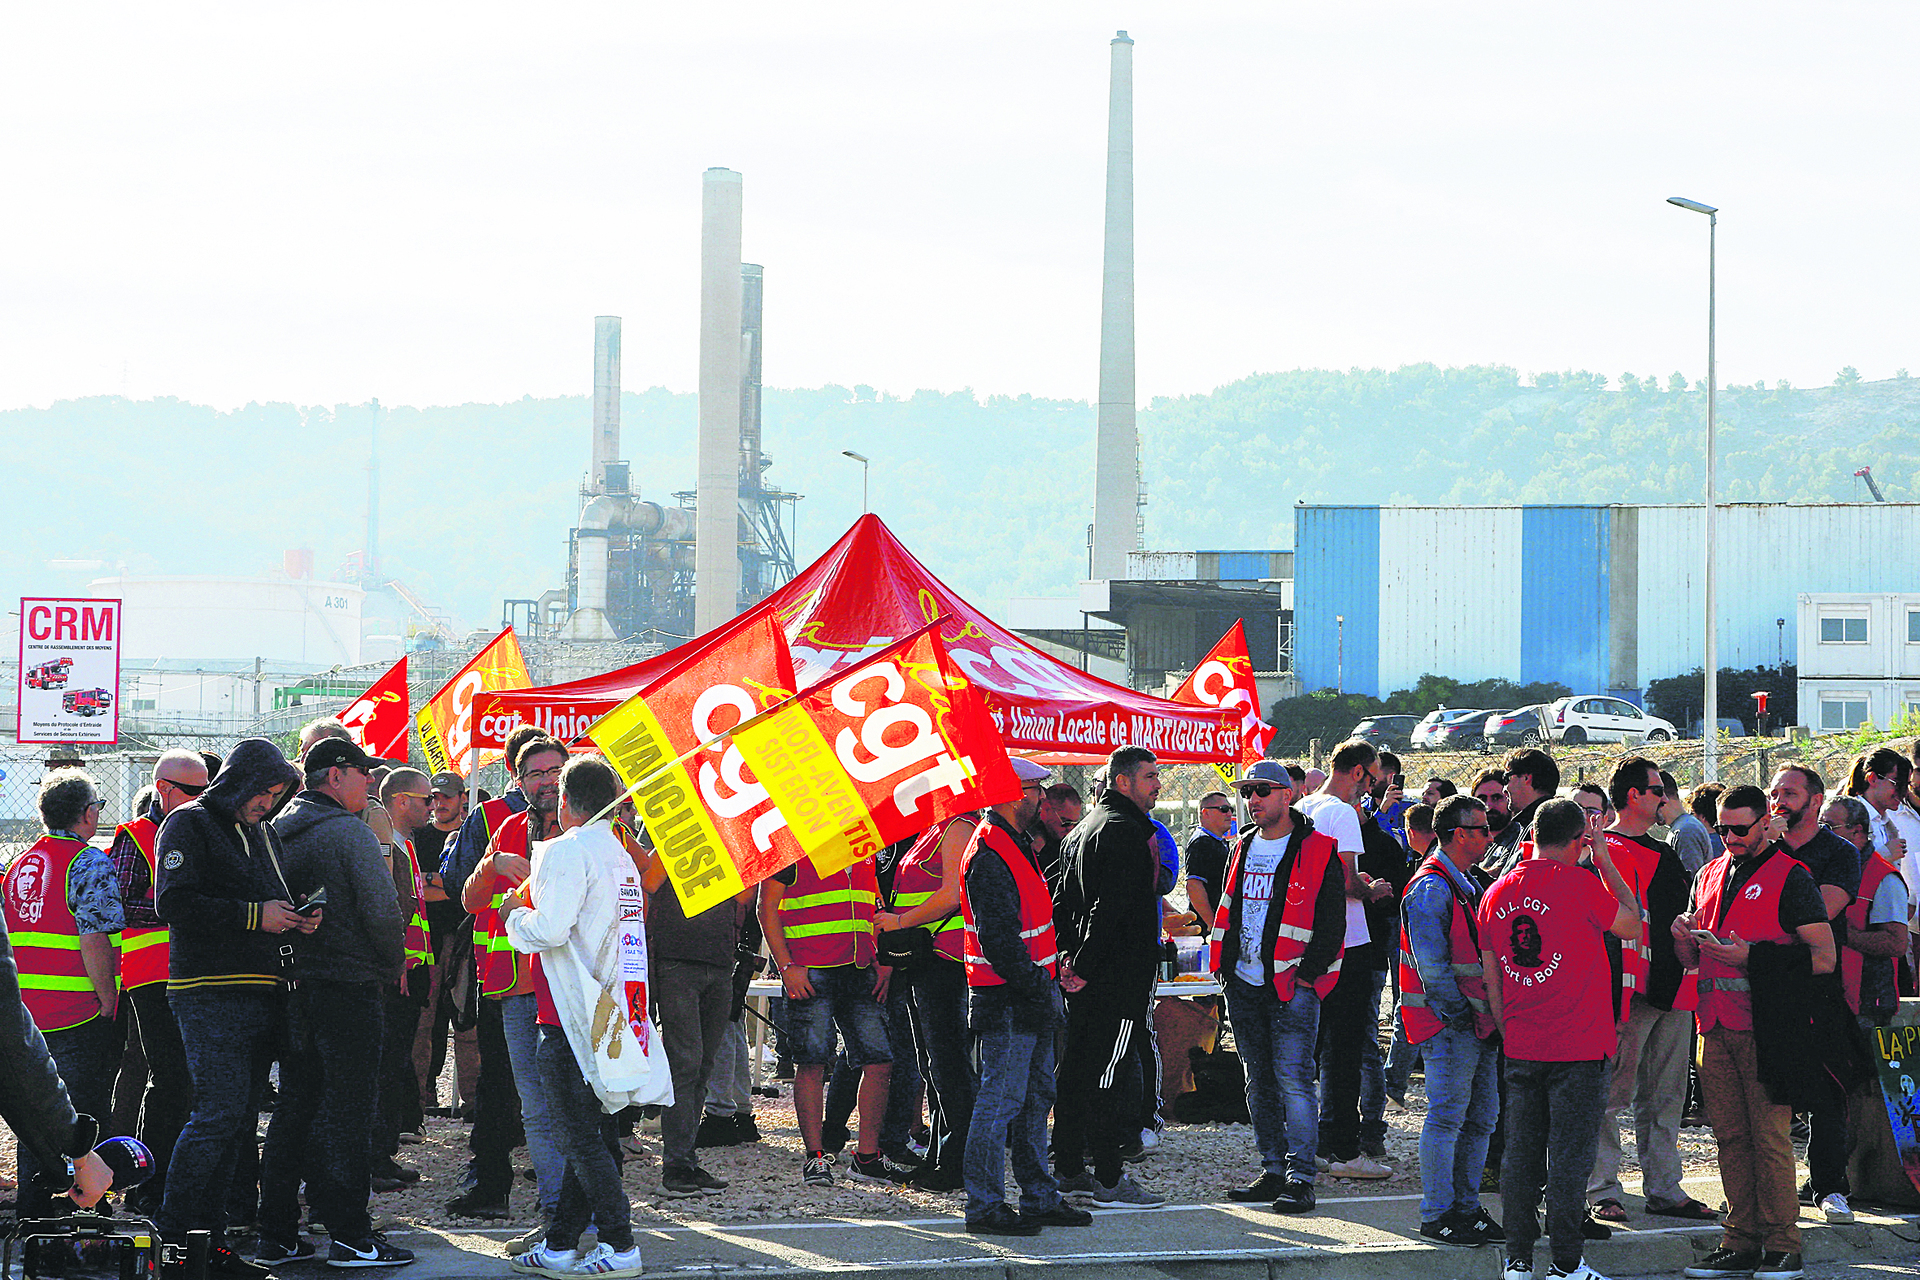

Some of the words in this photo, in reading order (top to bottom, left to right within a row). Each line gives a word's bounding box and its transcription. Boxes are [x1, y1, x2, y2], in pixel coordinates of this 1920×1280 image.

[325, 596, 332, 608] A
[334, 597, 348, 609] 301
[28, 606, 113, 641] CRM
[482, 697, 522, 715] la
[421, 720, 432, 738] UL
[480, 710, 522, 742] cgt
[831, 661, 977, 817] cgt
[1010, 706, 1055, 741] Union
[1057, 710, 1106, 744] Locale
[1110, 713, 1127, 745] de
[1131, 715, 1215, 752] MARTIGUES
[1216, 727, 1240, 756] cgt
[756, 738, 831, 834] SISTERON
[608, 721, 726, 898] VAUCLUSE
[19, 898, 44, 924] cgt
[1495, 901, 1520, 920] U.L.
[1523, 896, 1551, 916] CGT
[1501, 955, 1520, 982] Port
[1534, 952, 1562, 984] Bouc
